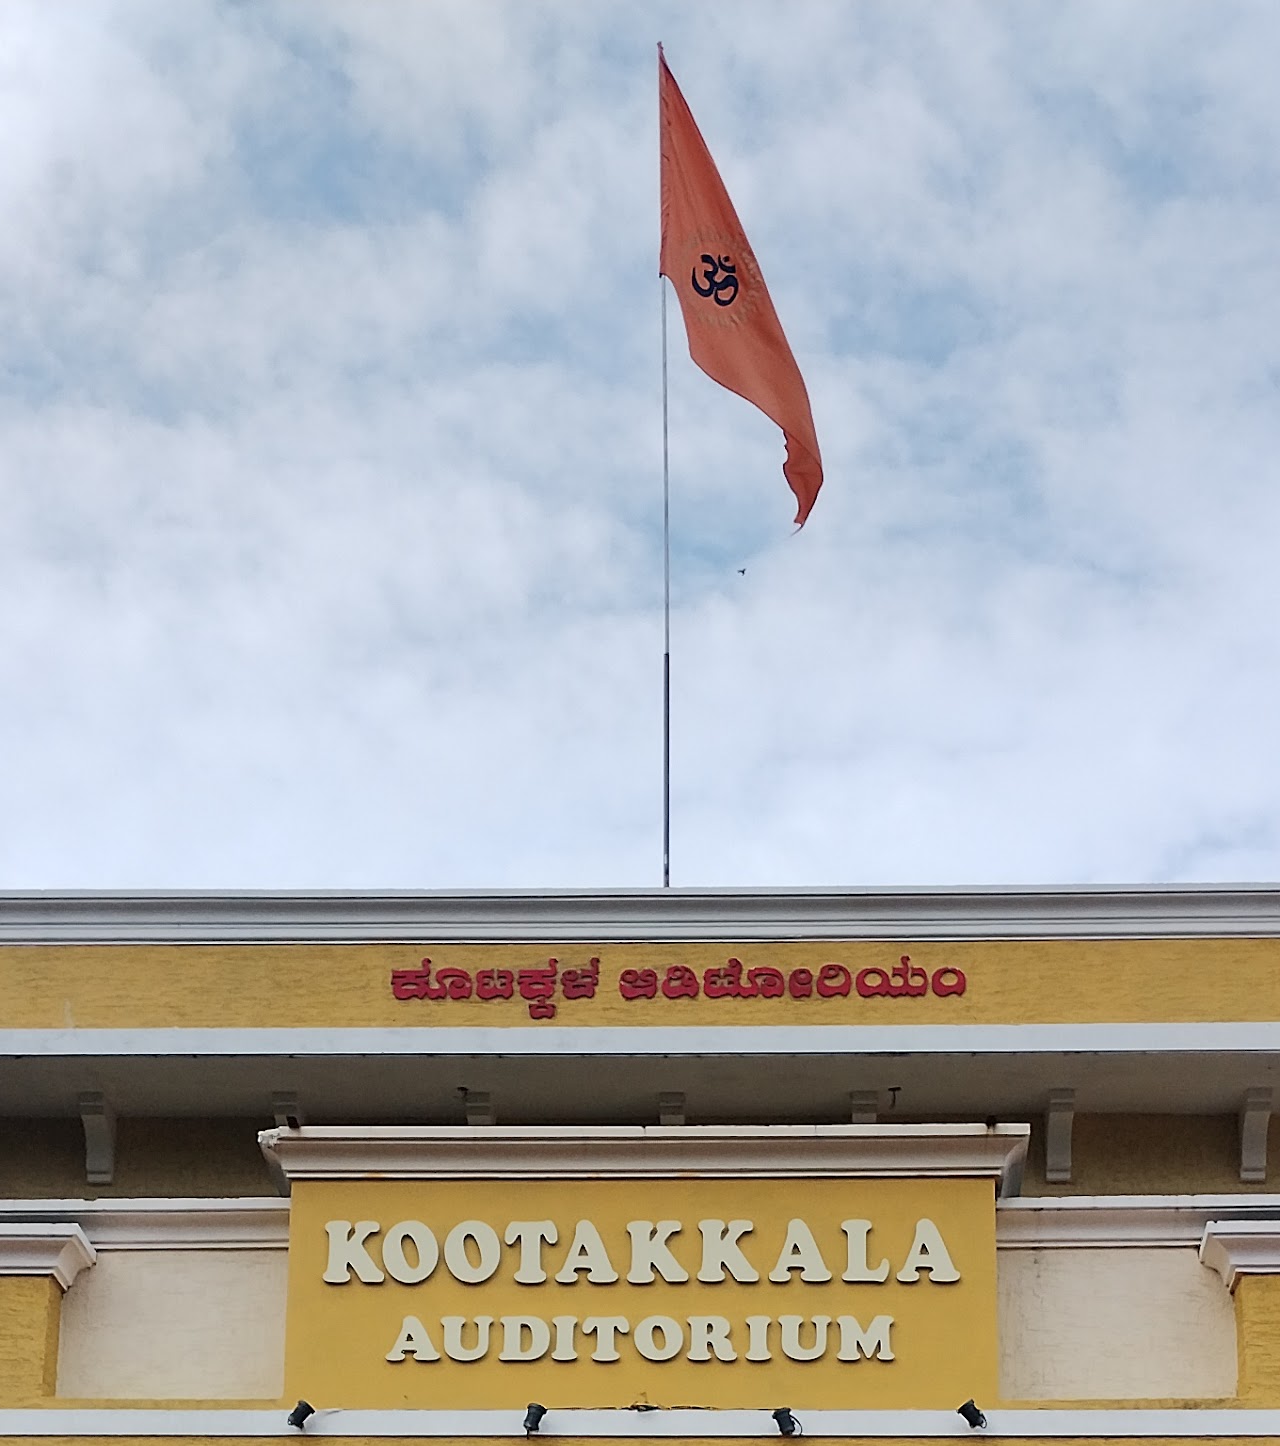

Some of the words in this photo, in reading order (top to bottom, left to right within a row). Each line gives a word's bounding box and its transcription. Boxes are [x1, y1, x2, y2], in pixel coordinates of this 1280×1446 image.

[620, 955, 967, 1000] ಆಡಿಟೋರಿಯಂ
[322, 1218, 961, 1285] KOOTAKKALA
[385, 1315, 897, 1362] AUDITORIUM
